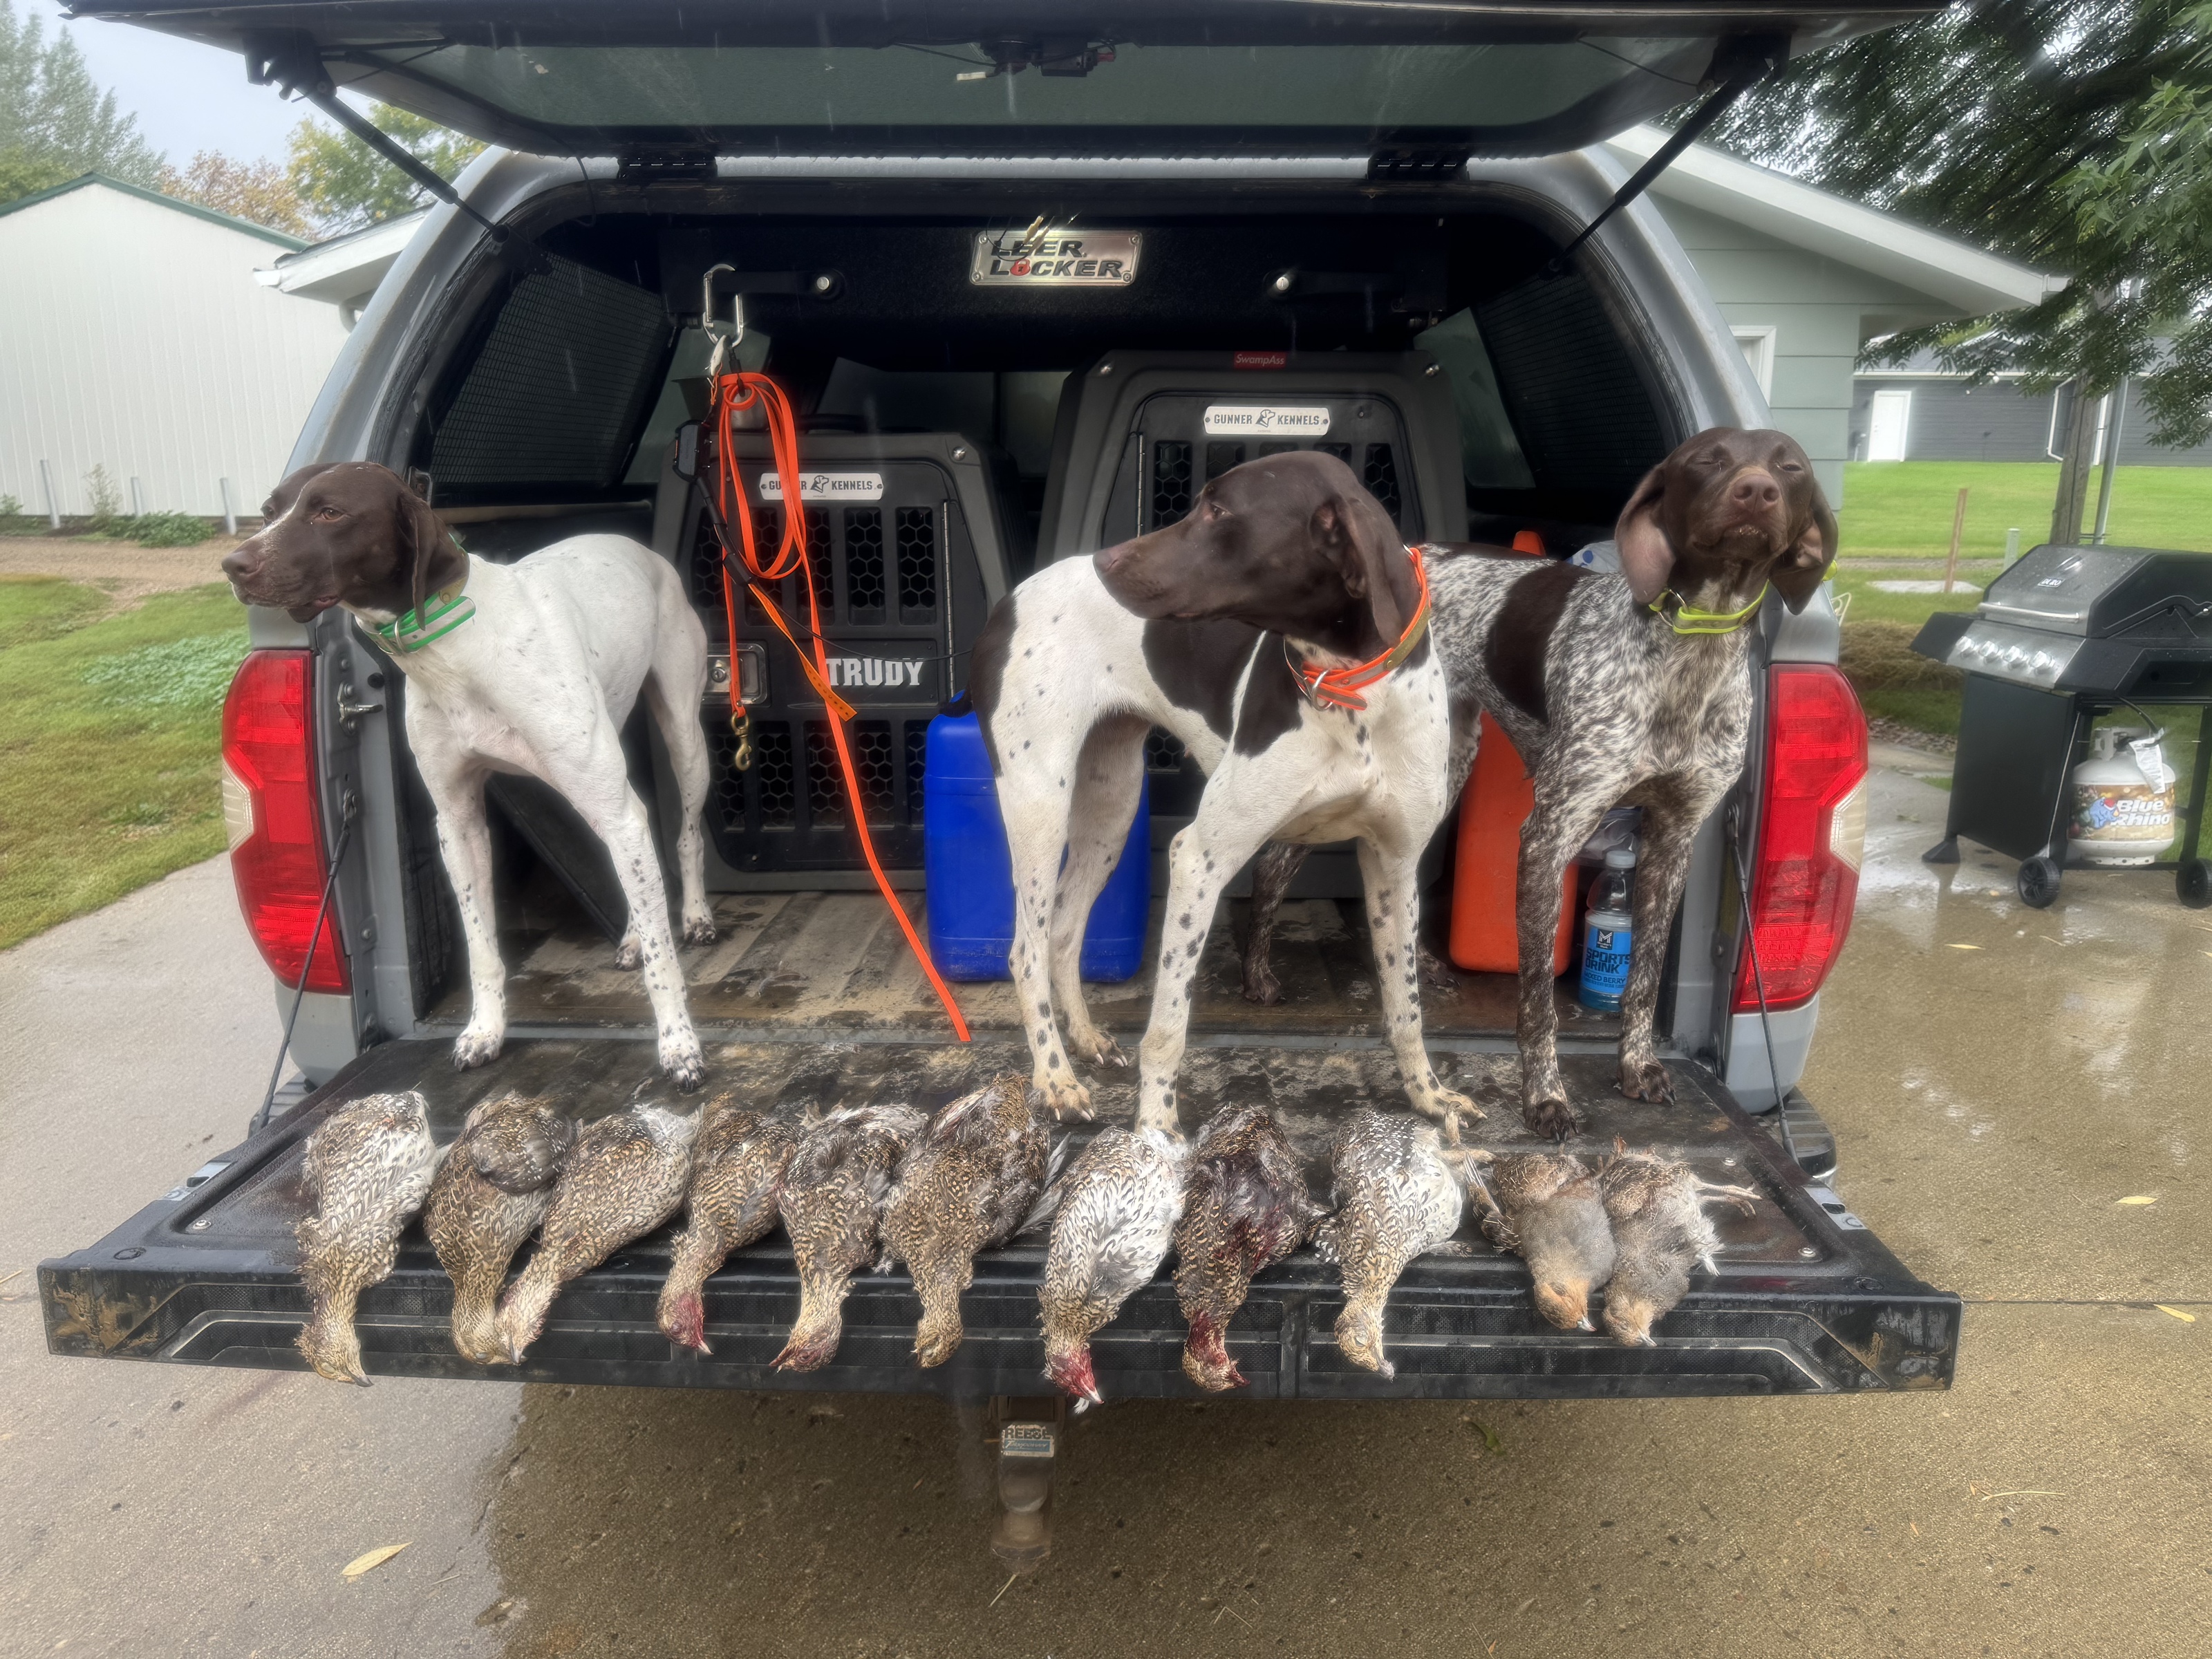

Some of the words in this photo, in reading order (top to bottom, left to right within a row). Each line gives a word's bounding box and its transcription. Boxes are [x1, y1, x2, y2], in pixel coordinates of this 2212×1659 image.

[991, 240, 1085, 258] LEER
[1236, 353, 1284, 366] SwampAss
[1214, 414, 1253, 424] GUNNER
[1277, 415, 1320, 425] KENNELS
[831, 480, 873, 490] KENNELS
[825, 658, 924, 686] TRUDY
[2115, 800, 2164, 813] Blue
[2110, 812, 2171, 826] Rhino
[1586, 947, 1630, 965] SPORTS
[1585, 957, 1620, 974] DRINK
